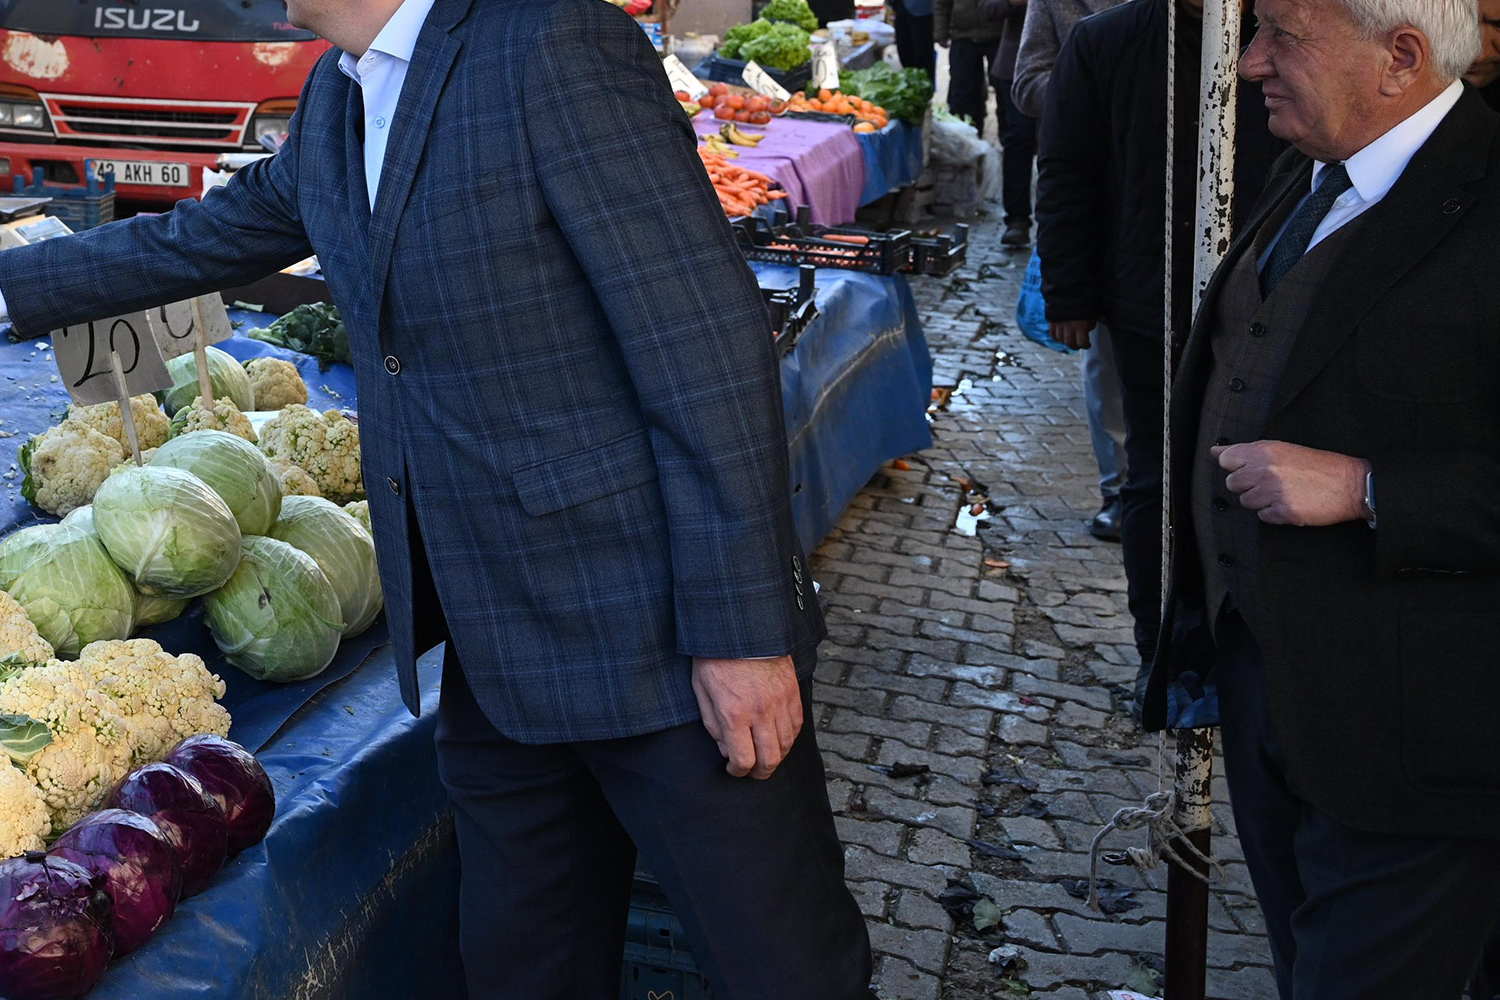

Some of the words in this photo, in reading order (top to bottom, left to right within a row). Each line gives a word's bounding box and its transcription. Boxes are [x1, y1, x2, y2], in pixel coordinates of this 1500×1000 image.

[94, 7, 200, 32] ISUZU
[124, 164, 152, 182] AKH
[161, 166, 181, 184] 60
